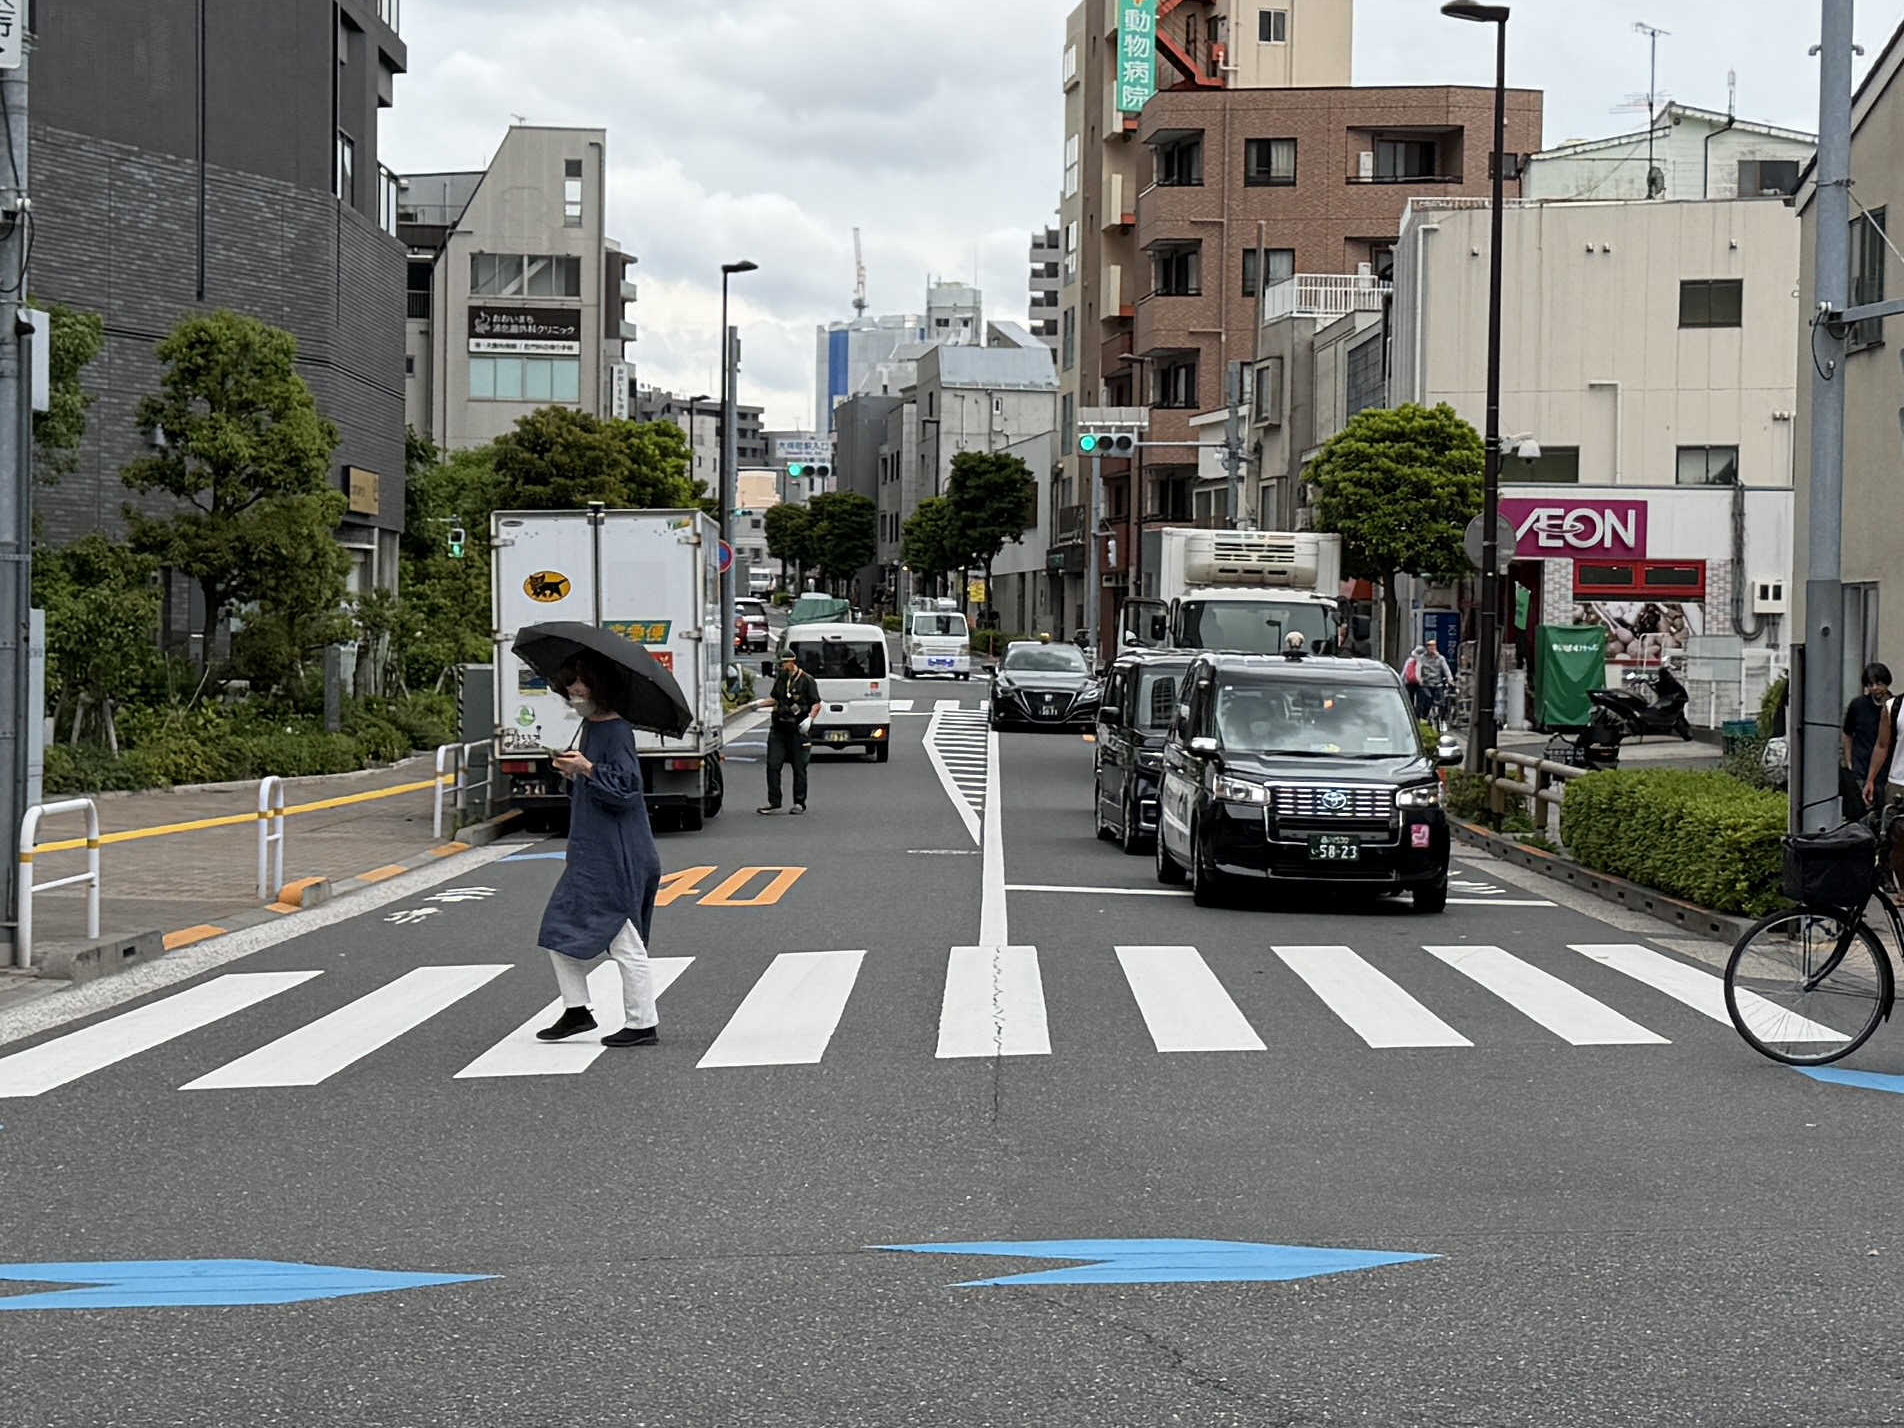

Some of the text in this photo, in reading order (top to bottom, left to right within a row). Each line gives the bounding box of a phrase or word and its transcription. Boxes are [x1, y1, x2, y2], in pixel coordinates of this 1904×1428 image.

[1122, 9, 1151, 109] 動物病院
[654, 865, 809, 907] 40
